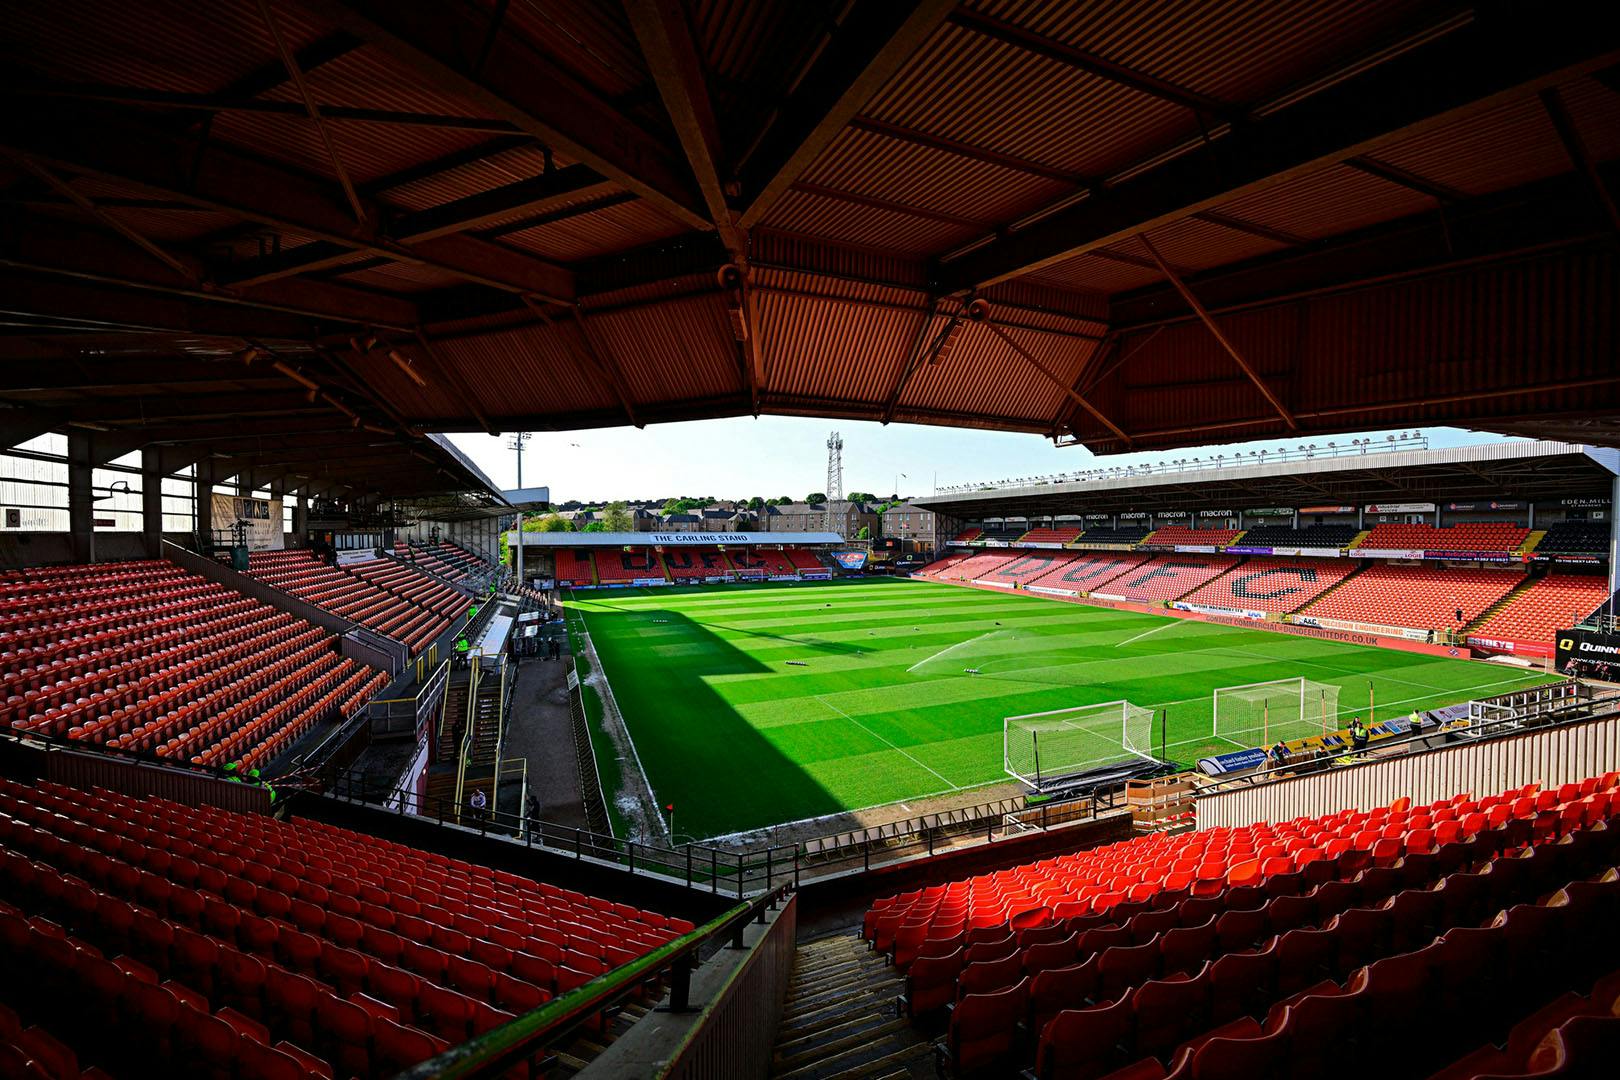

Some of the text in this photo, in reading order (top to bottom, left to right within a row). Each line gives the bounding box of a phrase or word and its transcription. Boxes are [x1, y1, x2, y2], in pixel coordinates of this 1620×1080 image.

[9, 513, 17, 523] C
[1200, 509, 1233, 517] macron
[1206, 615, 1233, 625] CONTACT
[1320, 620, 1353, 631] PRECISION
[1355, 623, 1404, 636] ENGINEERING
[1579, 642, 1620, 655] QUINN
